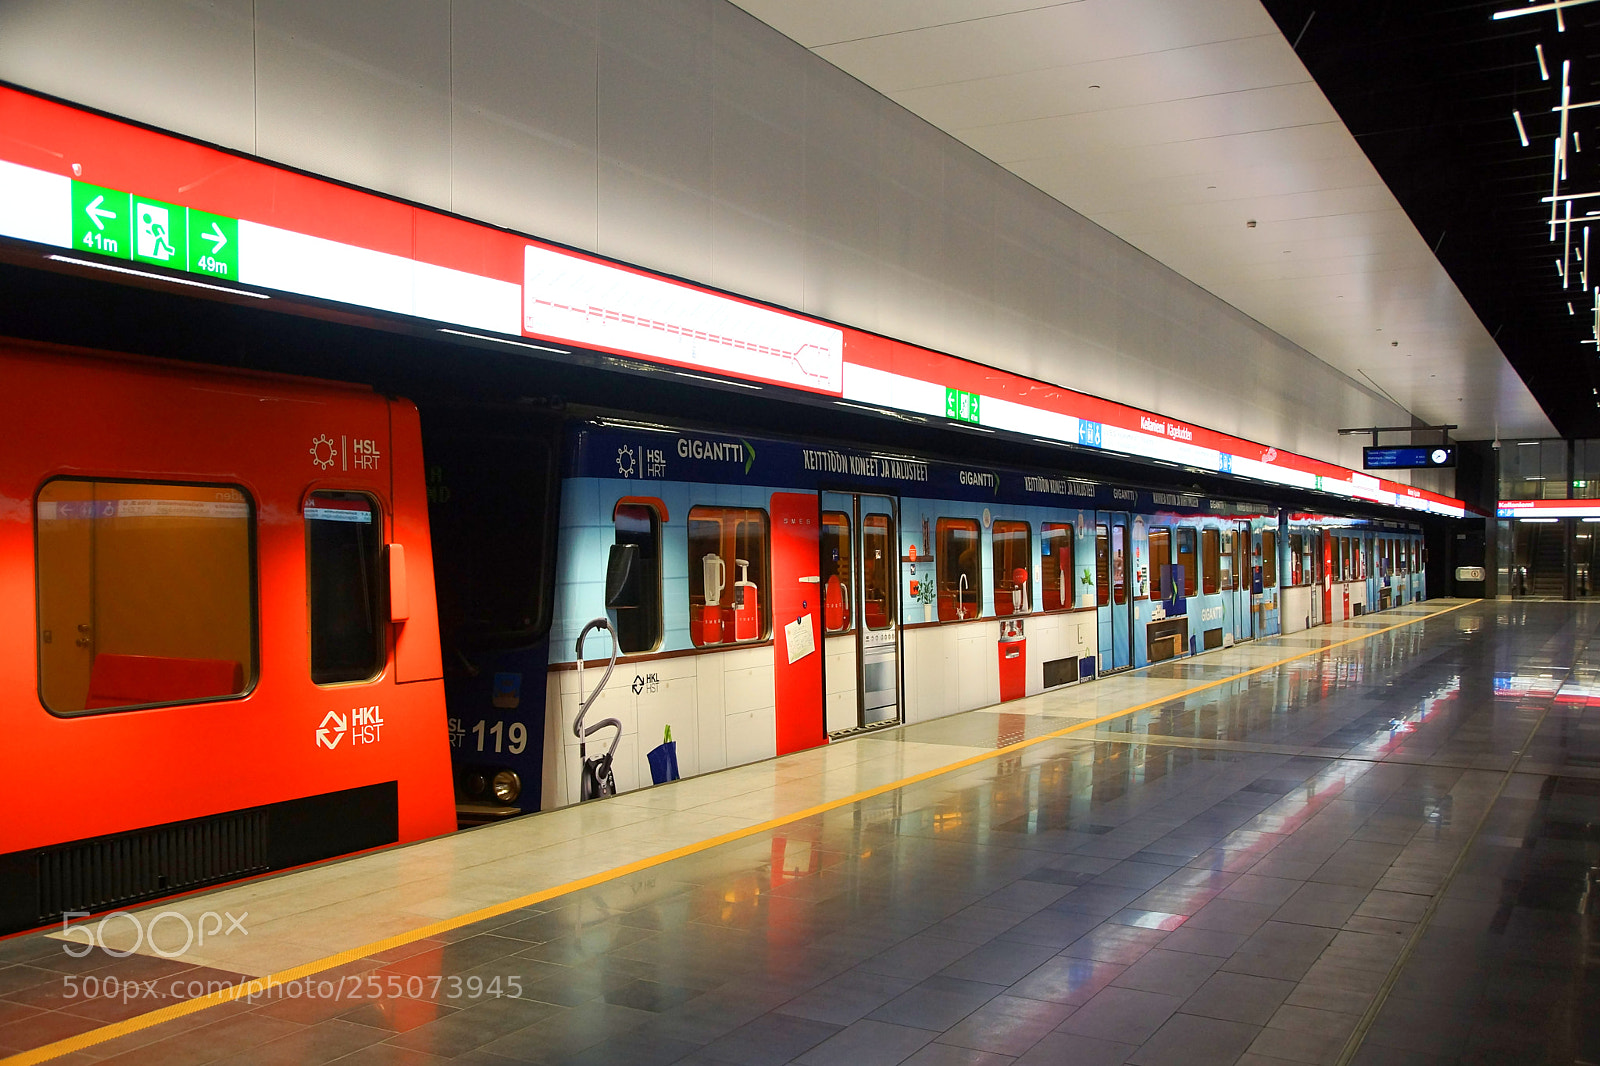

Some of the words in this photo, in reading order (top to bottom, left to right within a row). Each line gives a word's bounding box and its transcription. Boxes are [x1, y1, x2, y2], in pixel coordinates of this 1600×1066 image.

[82, 231, 118, 253] 41m
[198, 255, 228, 274] 49m
[353, 439, 380, 455] HSL
[677, 438, 744, 463] GIGANTTI
[353, 455, 380, 470] HRT
[646, 449, 666, 464] HSL
[647, 463, 666, 478] HRT
[849, 455, 878, 477] KONEET
[881, 460, 890, 478] JA
[959, 471, 994, 488] GIGANTTI
[646, 672, 660, 683] HKL
[352, 705, 384, 727] HKL
[447, 717, 466, 733] SL
[352, 723, 384, 746] HST
[448, 733, 466, 748] RT
[472, 719, 528, 755] 119
